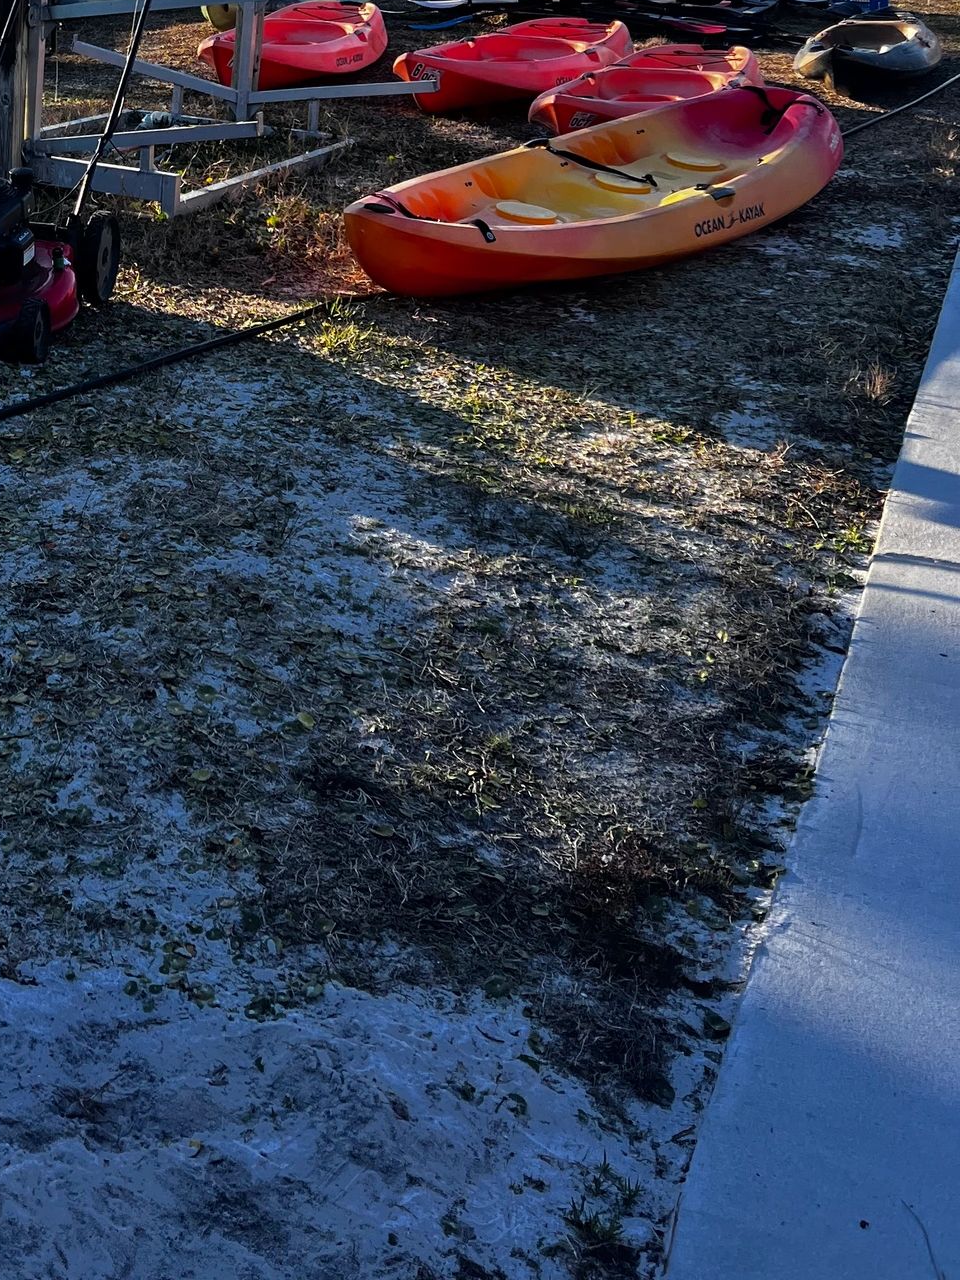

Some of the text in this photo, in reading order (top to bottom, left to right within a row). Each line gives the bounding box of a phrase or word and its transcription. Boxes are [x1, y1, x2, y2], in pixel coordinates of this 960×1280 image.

[412, 63, 424, 78] 6
[570, 117, 593, 127] OCT
[694, 201, 766, 238] OCEAN KAYAK
